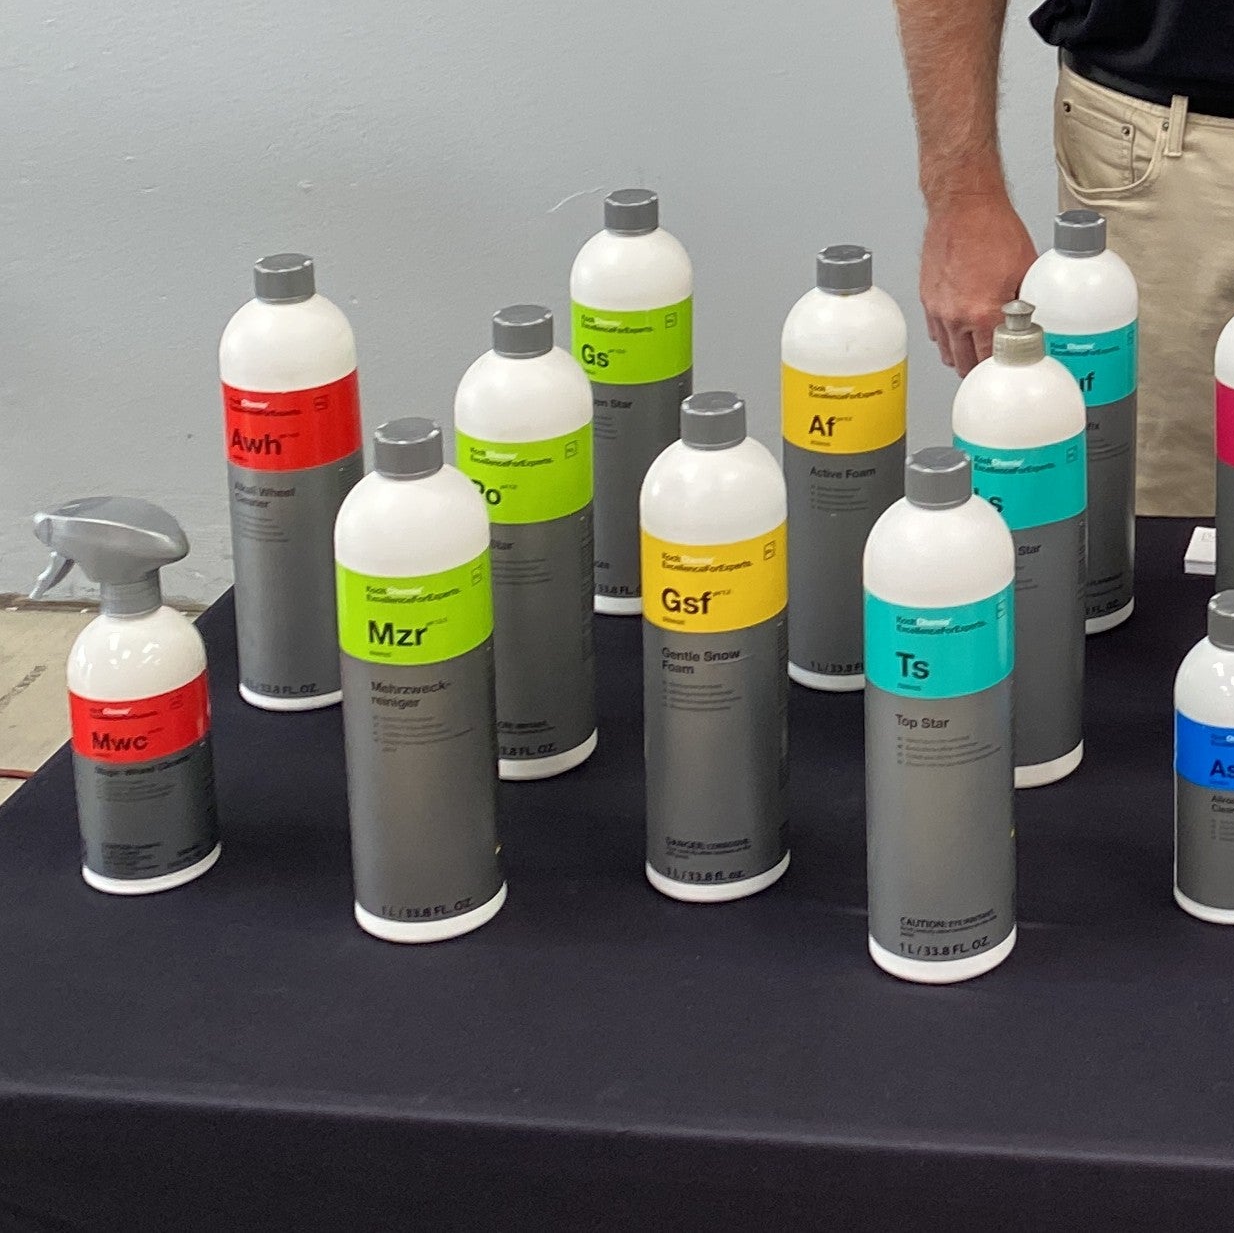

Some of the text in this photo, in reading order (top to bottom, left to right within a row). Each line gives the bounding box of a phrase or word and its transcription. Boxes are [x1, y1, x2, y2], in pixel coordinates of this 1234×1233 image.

[581, 343, 609, 368] Gs
[808, 414, 836, 437] Af
[231, 428, 282, 455] Awh
[809, 466, 876, 479] Active Foam
[1017, 544, 1042, 556] Star
[661, 587, 712, 615] Gsf
[368, 620, 428, 647] Mzr
[661, 647, 741, 662] Gentle Snow
[662, 660, 694, 674] Foam
[895, 651, 930, 680] Ts
[895, 713, 950, 730] Top Star
[92, 731, 149, 751] Mwc
